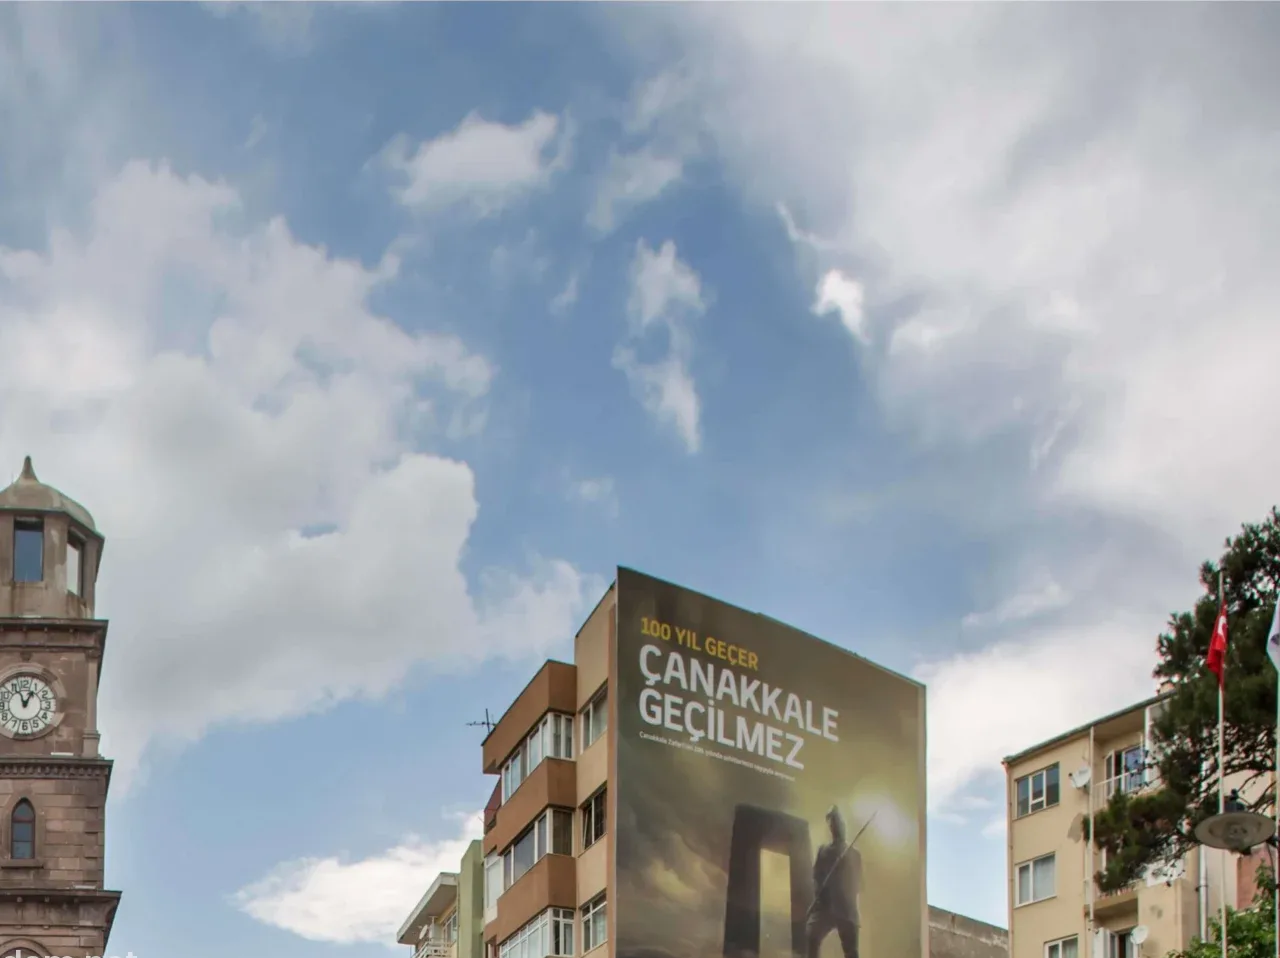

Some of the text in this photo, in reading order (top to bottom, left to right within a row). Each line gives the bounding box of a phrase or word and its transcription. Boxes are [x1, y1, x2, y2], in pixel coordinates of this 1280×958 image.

[640, 617, 759, 671] 100 YIL GEÇER
[20, 680, 29, 689] 12
[34, 683, 38, 691] 1
[0, 691, 9, 699] 10
[42, 690, 48, 699] 2
[639, 644, 840, 743] ÇANAKKALE
[0, 702, 5, 711] 9
[45, 701, 51, 709] 3
[2, 712, 8, 721] 8
[41, 712, 48, 721] 4
[12, 720, 18, 728] 7
[22, 721, 28, 730] 6
[33, 718, 39, 727] 5
[638, 688, 805, 770] GEÇİLMEZ
